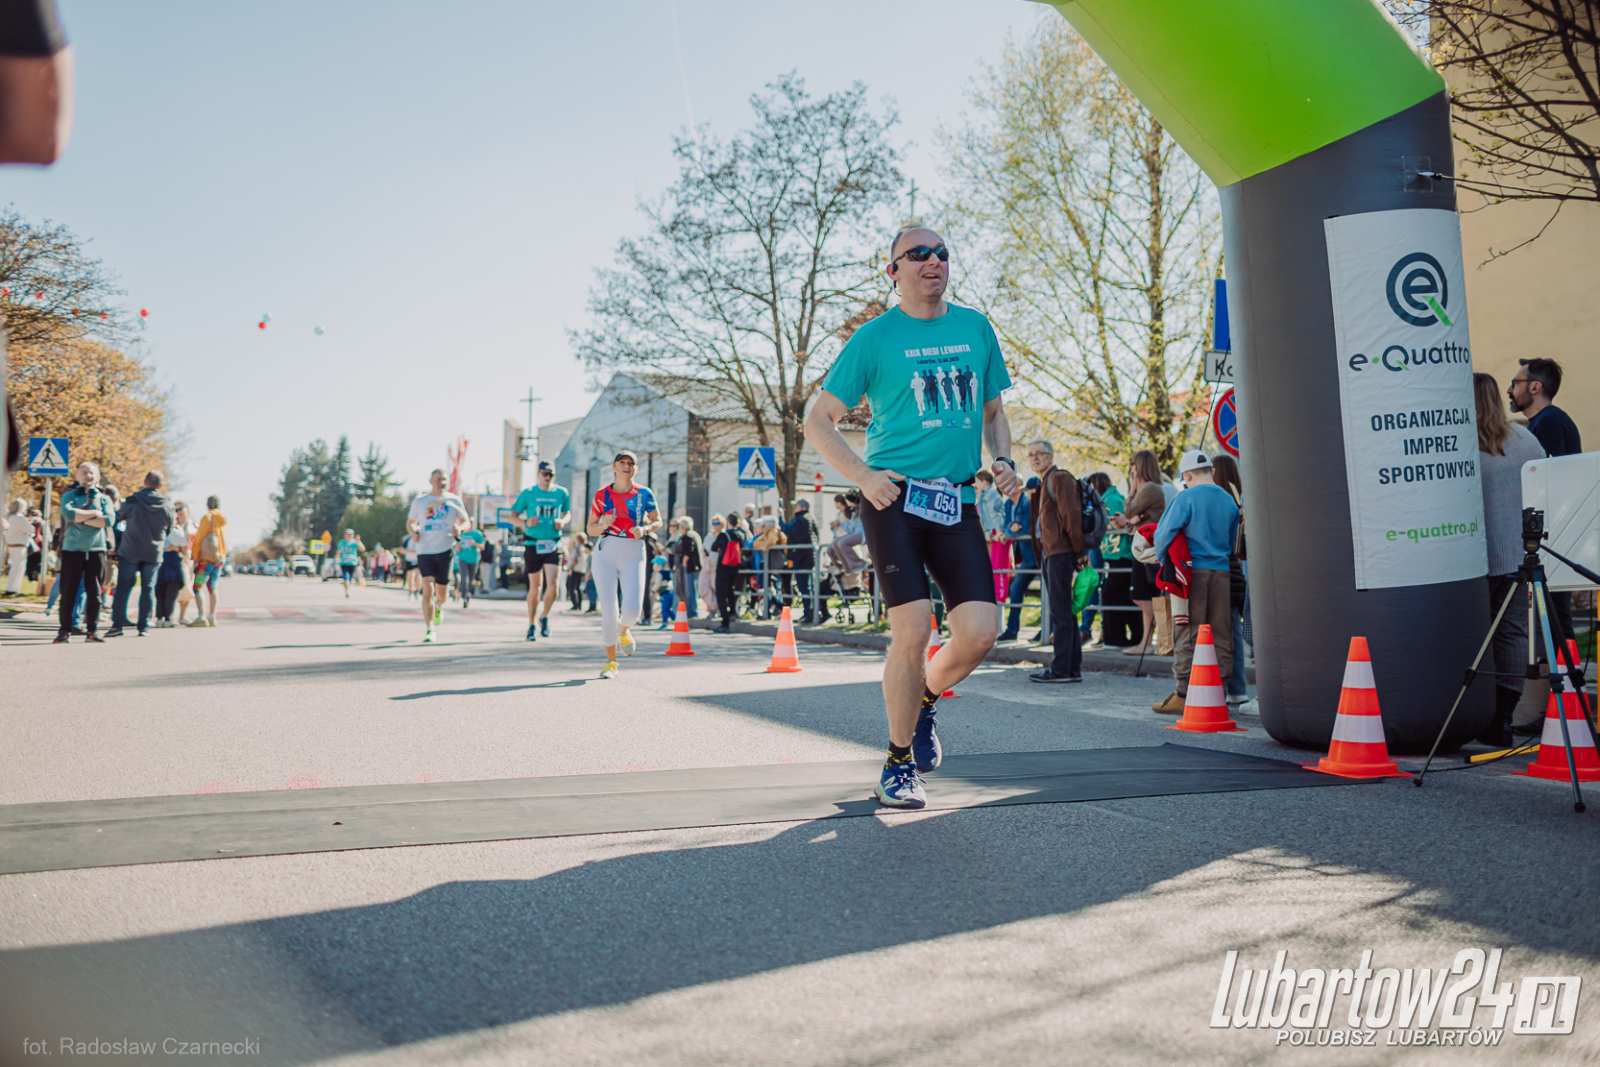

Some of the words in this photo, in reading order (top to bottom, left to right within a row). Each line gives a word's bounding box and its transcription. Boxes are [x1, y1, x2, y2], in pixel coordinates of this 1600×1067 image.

[1371, 408, 1471, 432] ORGANIZACJA
[1403, 435, 1459, 457] IMPREZ
[1379, 460, 1476, 486] SPORTOWYCH
[934, 492, 956, 515] 054
[1385, 516, 1479, 544] e-quattro.pl
